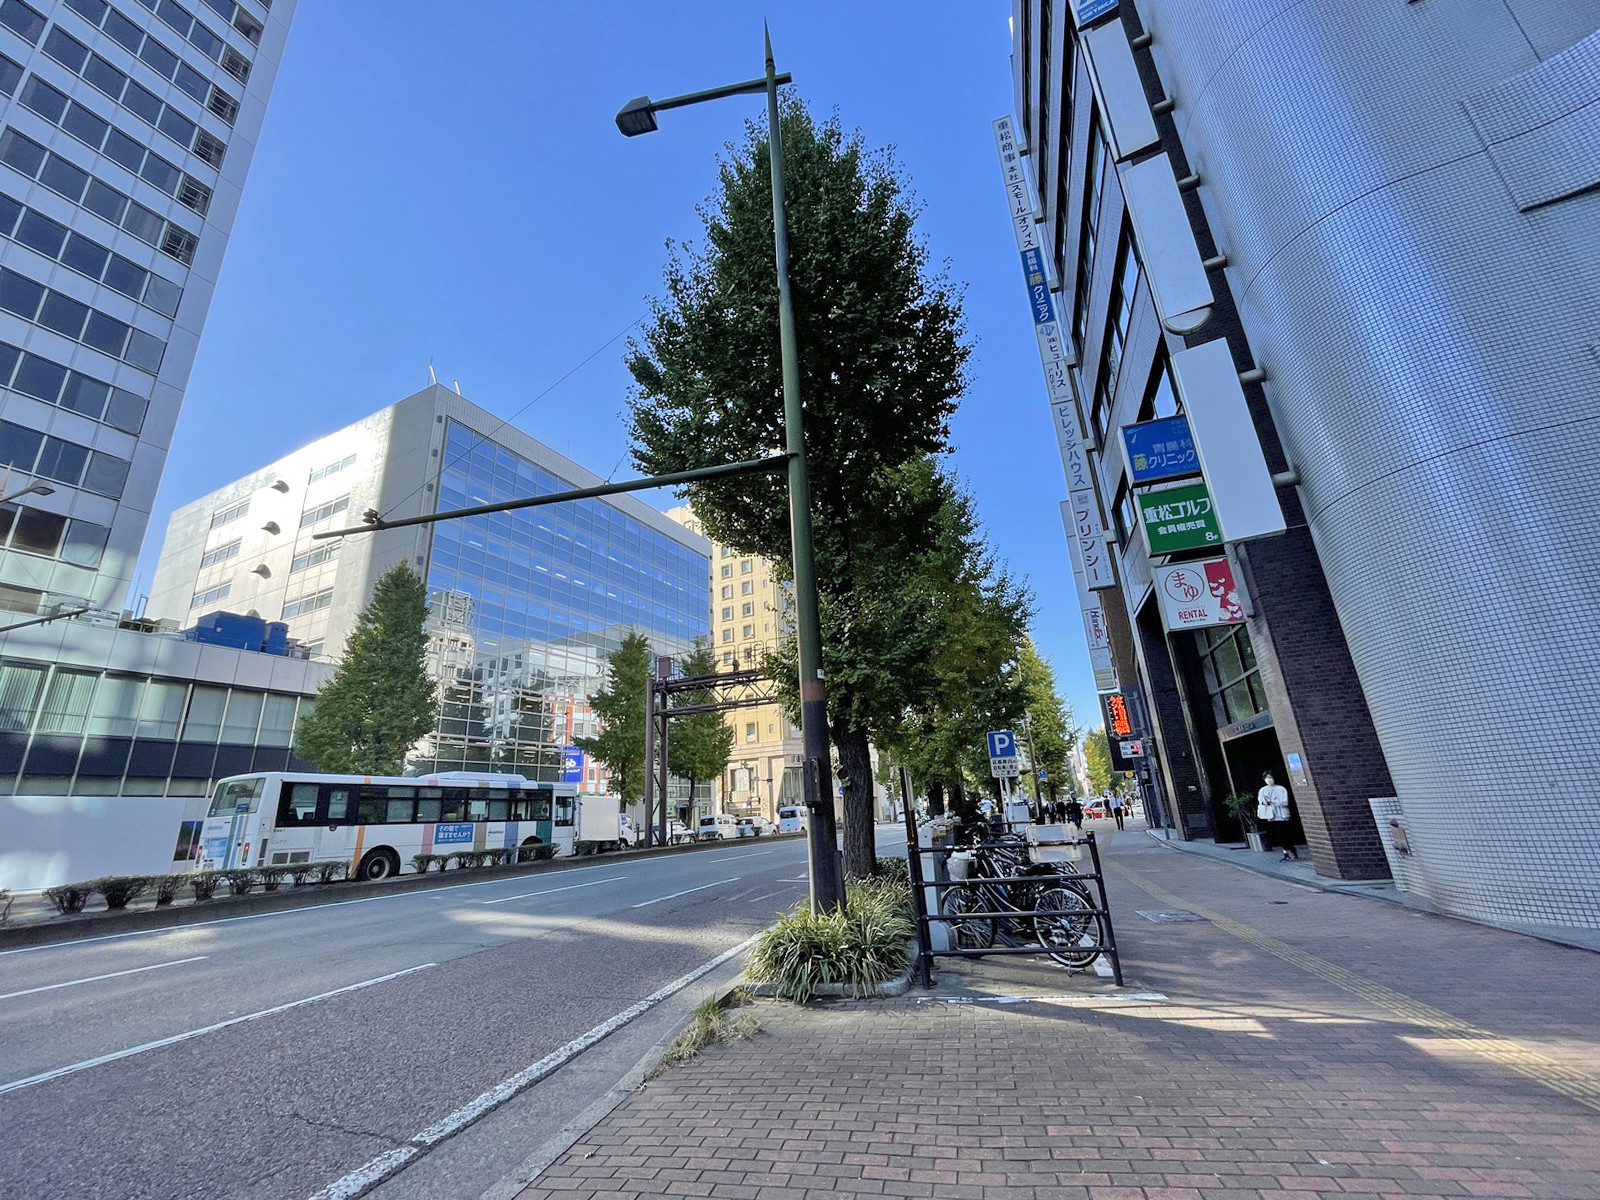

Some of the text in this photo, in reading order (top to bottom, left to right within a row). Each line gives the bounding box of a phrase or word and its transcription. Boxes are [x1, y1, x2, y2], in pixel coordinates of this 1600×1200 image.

[1011, 184, 1034, 248] スモールオフィス
[1059, 406, 1085, 486] ビレッジハウス
[1132, 451, 1195, 471] 藤クリニック
[1143, 497, 1212, 524] 重松ゴルフ
[1157, 519, 1207, 535] 会員権売買
[1205, 531, 1219, 542] 8F
[1076, 509, 1099, 581] プリンシー
[1177, 609, 1208, 621] RENTAL
[994, 734, 1010, 755] P
